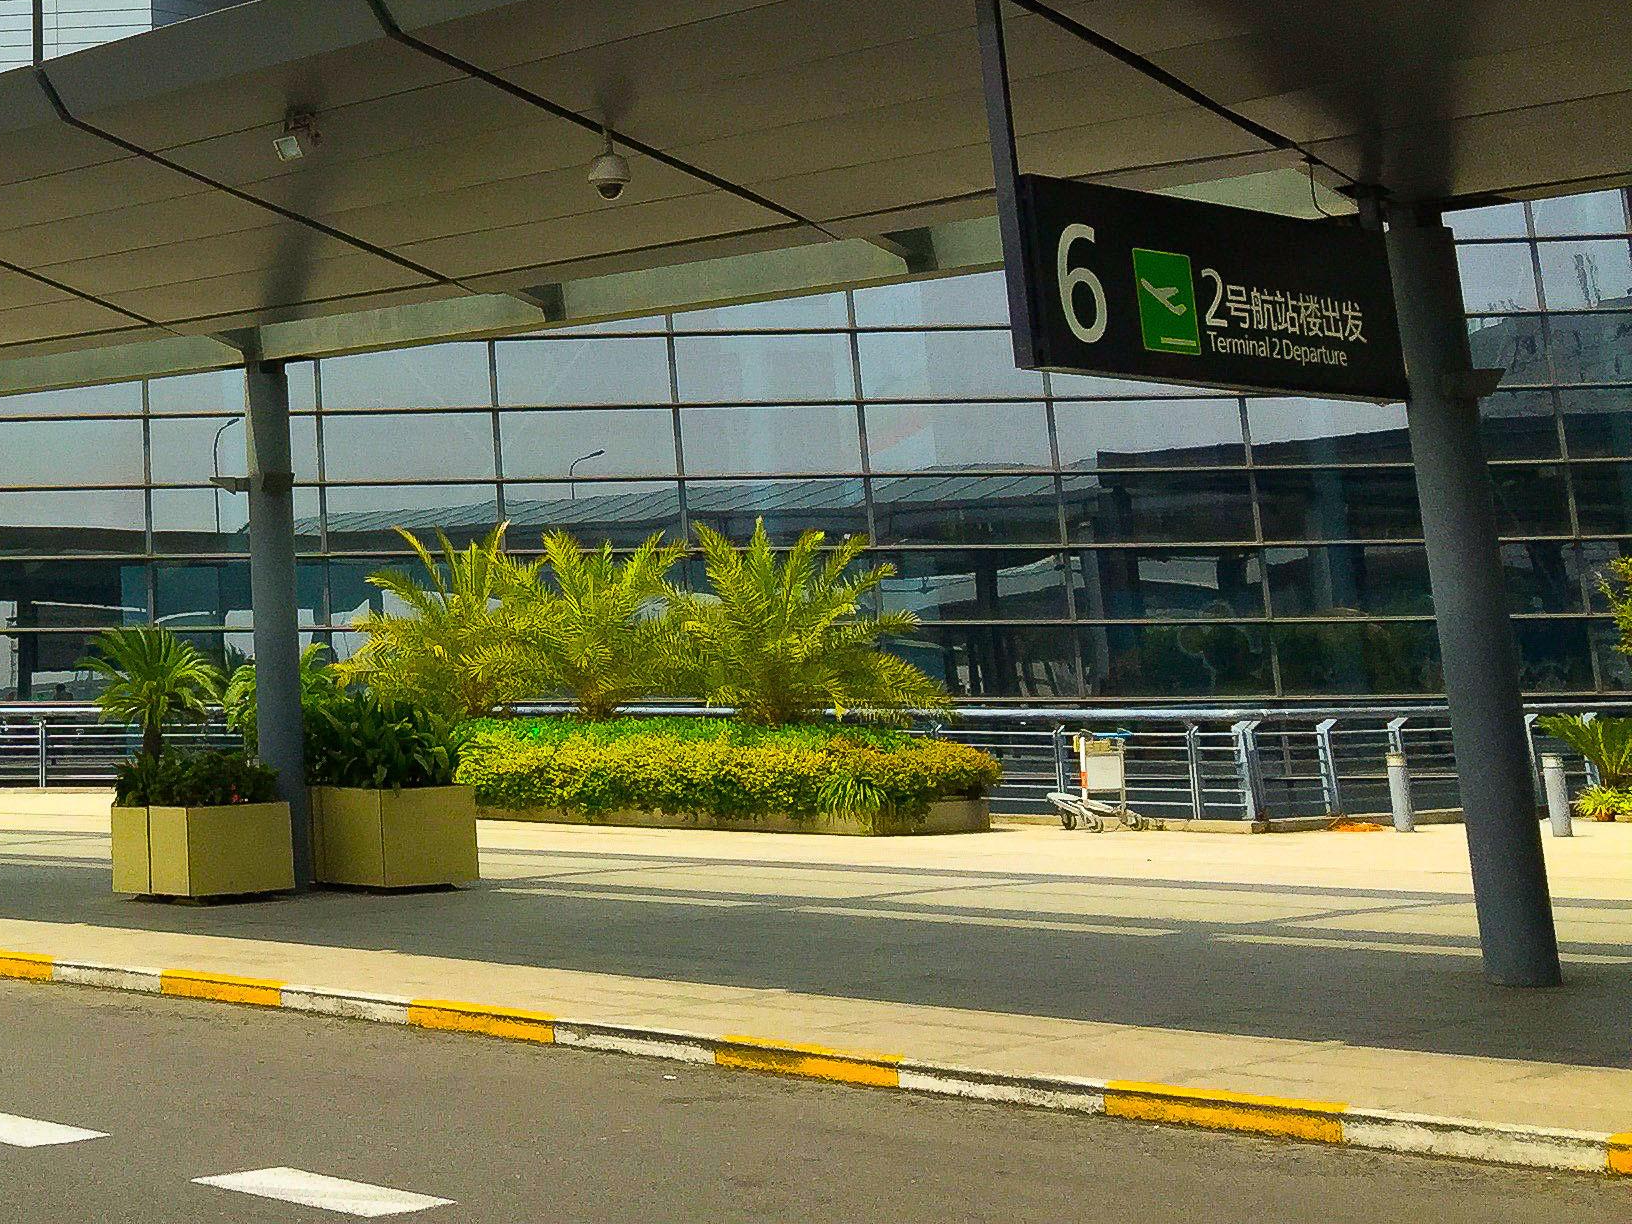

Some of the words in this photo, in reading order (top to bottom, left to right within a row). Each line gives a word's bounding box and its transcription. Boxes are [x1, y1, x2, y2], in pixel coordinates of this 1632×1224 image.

[1056, 222, 1108, 344] 6
[1201, 268, 1367, 344] 2号航站楼出发
[1206, 330, 1270, 358] Terminal
[1272, 337, 1282, 359] 2
[1282, 339, 1348, 367] Departure
